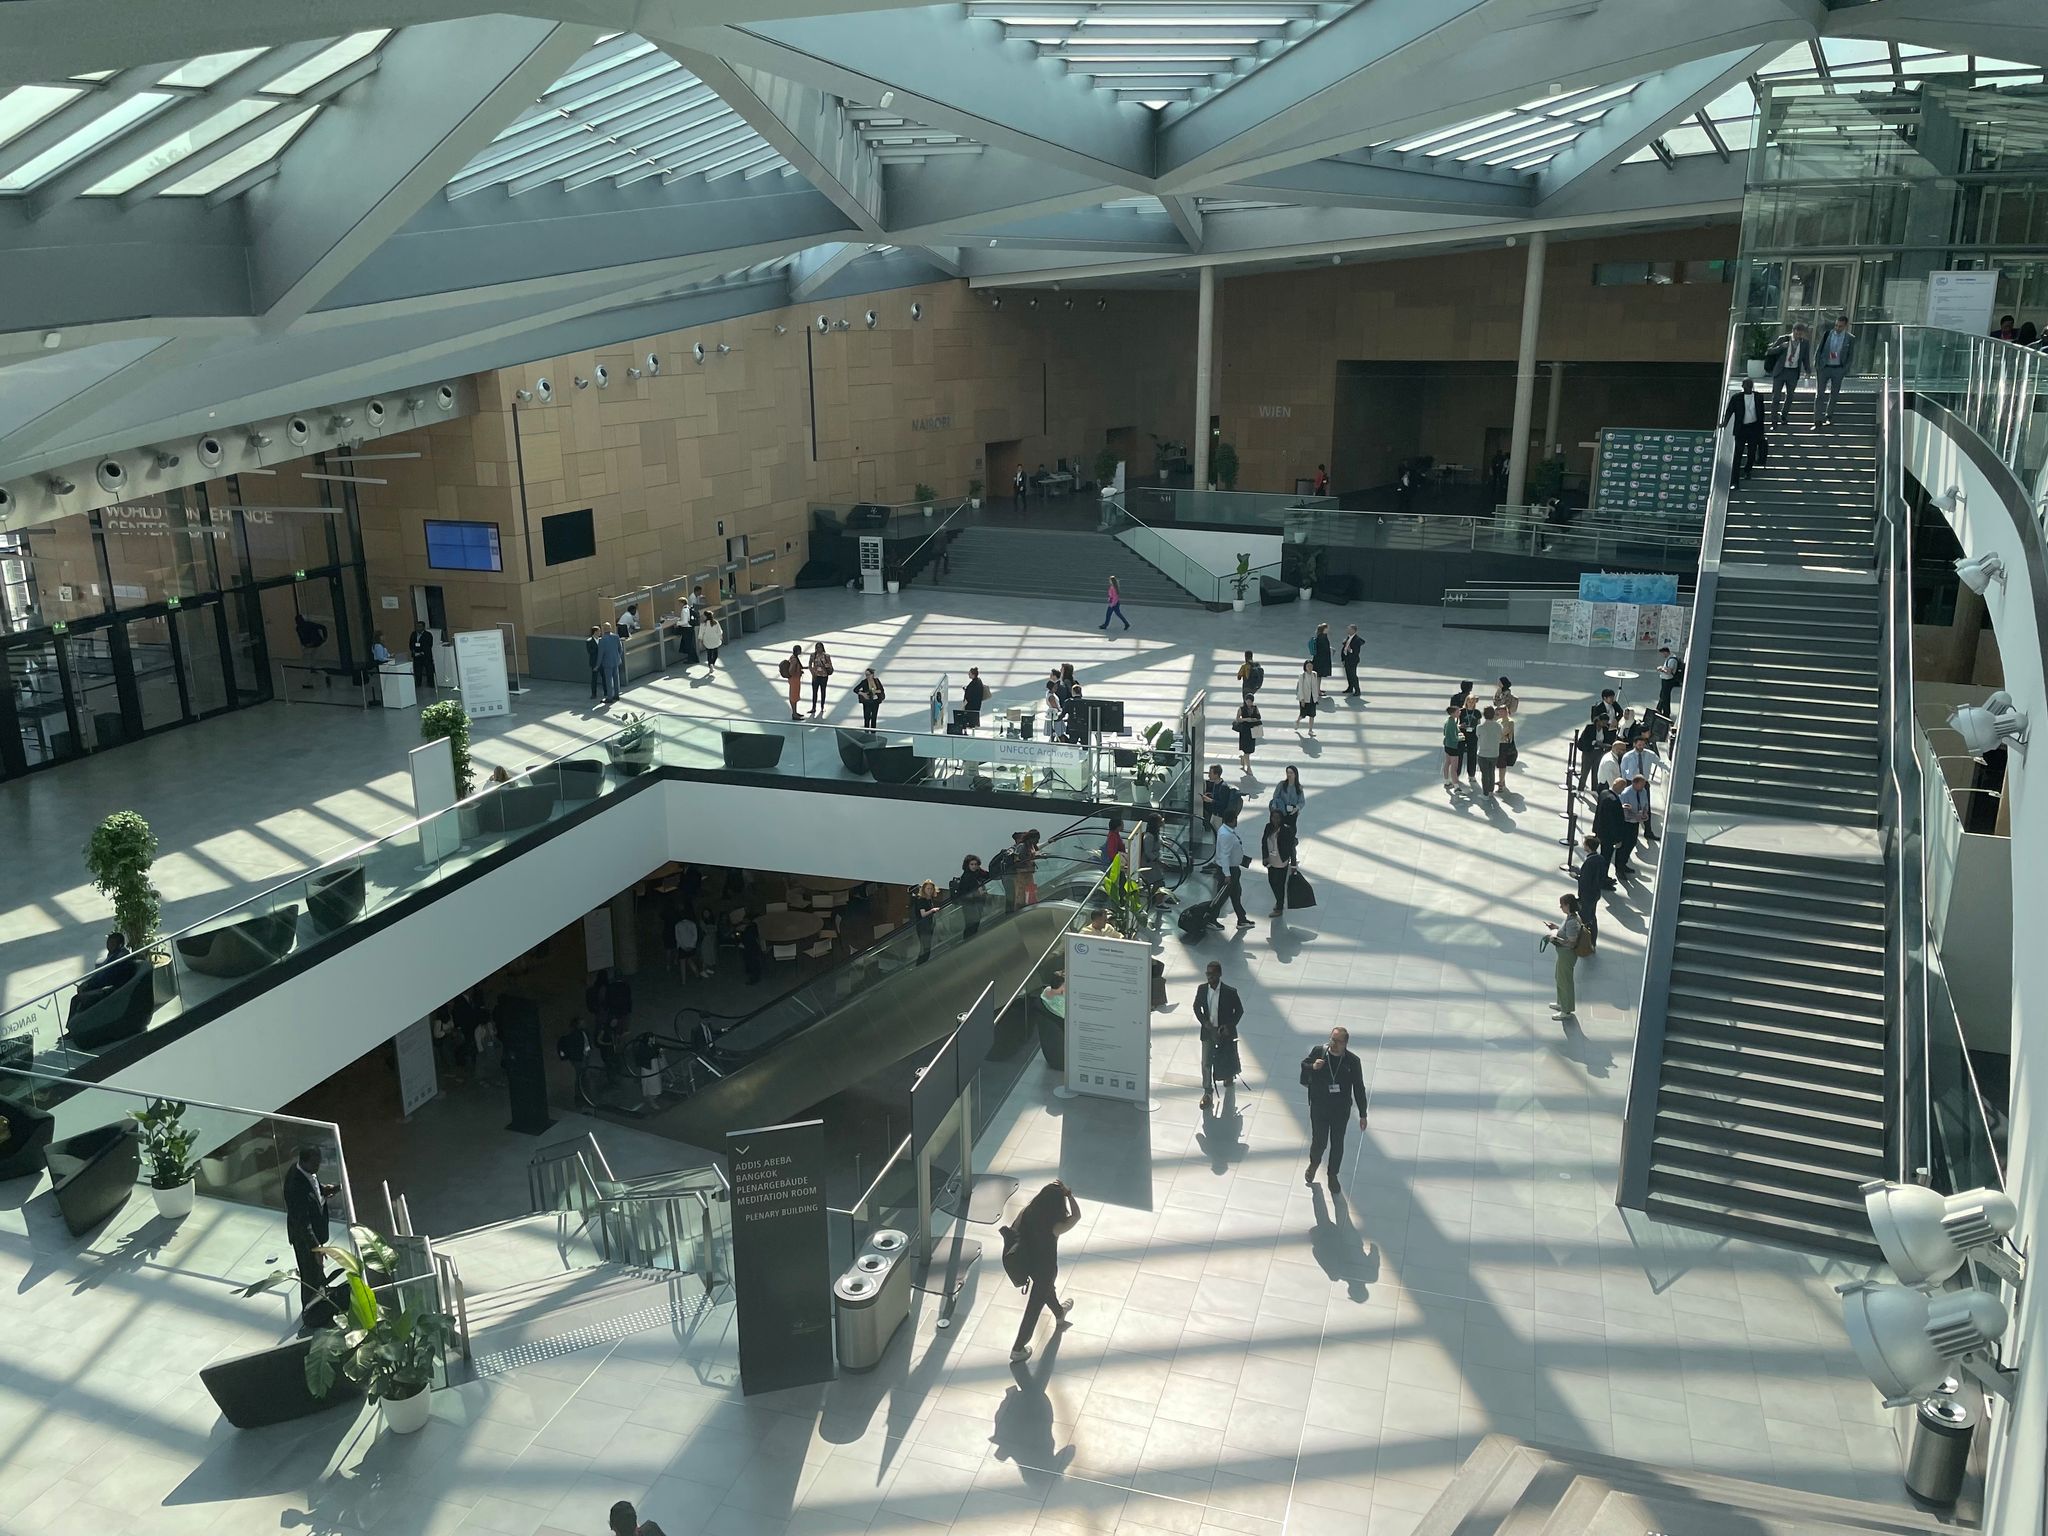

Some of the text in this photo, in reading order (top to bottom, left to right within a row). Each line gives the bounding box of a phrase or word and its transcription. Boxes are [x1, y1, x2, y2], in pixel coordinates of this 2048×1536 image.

[1259, 406, 1291, 417] WIEN
[999, 745, 1073, 758] UNFCCC Archives
[735, 1156, 792, 1171] ADDIS ABEBA
[736, 1169, 778, 1183] BANGKOK
[737, 1186, 817, 1206] MEDITATION ROOM
[745, 1204, 818, 1222] PLENARY BUILDING
